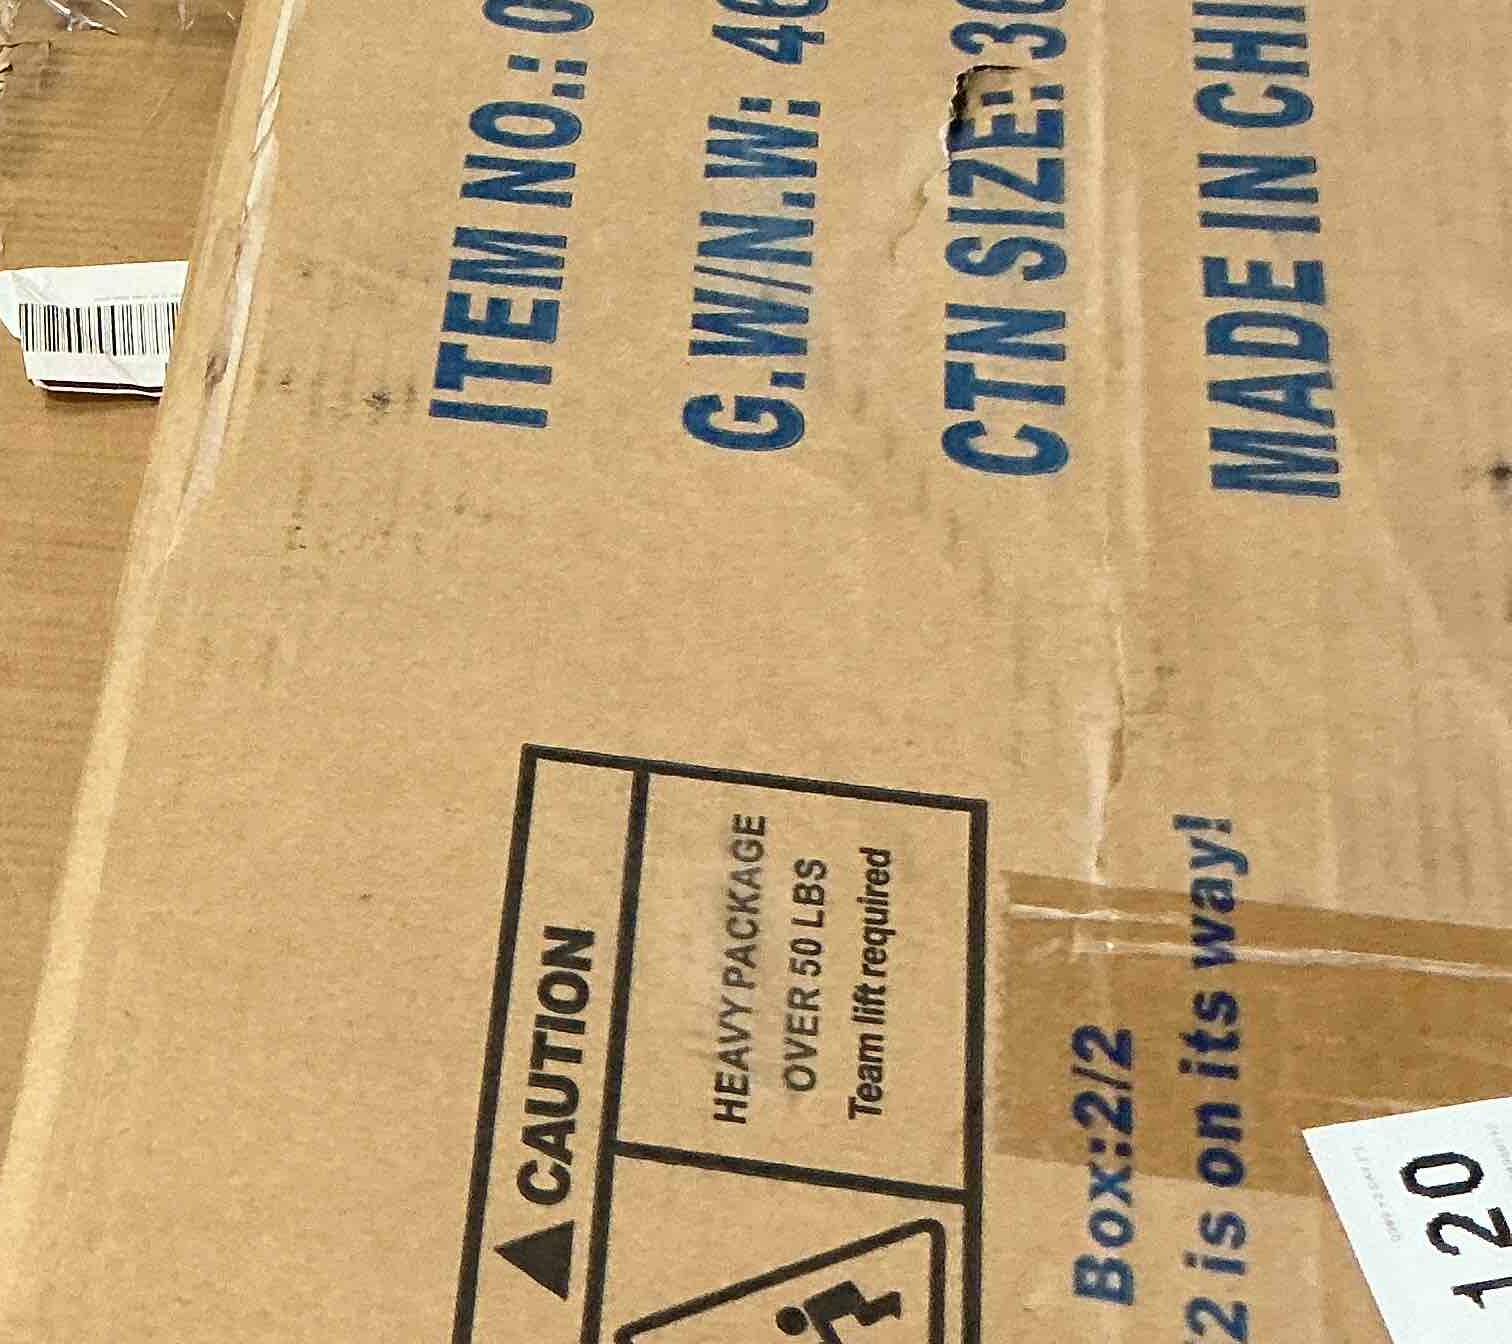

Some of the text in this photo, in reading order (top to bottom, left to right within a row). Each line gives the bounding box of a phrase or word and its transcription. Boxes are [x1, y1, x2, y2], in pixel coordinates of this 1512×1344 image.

[460, 54, 588, 209] NO.:
[1196, 152, 1322, 234] IN
[428, 224, 569, 429] ITEM
[682, 96, 821, 452] G.W/N.W:
[940, 301, 1070, 477] CTN
[1202, 256, 1342, 498] MADE
[713, 813, 767, 1125] HEAVY PACKAGE
[782, 857, 828, 1092] OVER 50 LBS
[848, 847, 896, 1120] Team lift required
[1172, 813, 1249, 970] way!
[516, 925, 596, 1206] CAUTION
[1179, 989, 1241, 1080] its
[1072, 1022, 1135, 1307] Box:2/2
[1184, 1209, 1248, 1277] is
[1194, 1102, 1247, 1190] on
